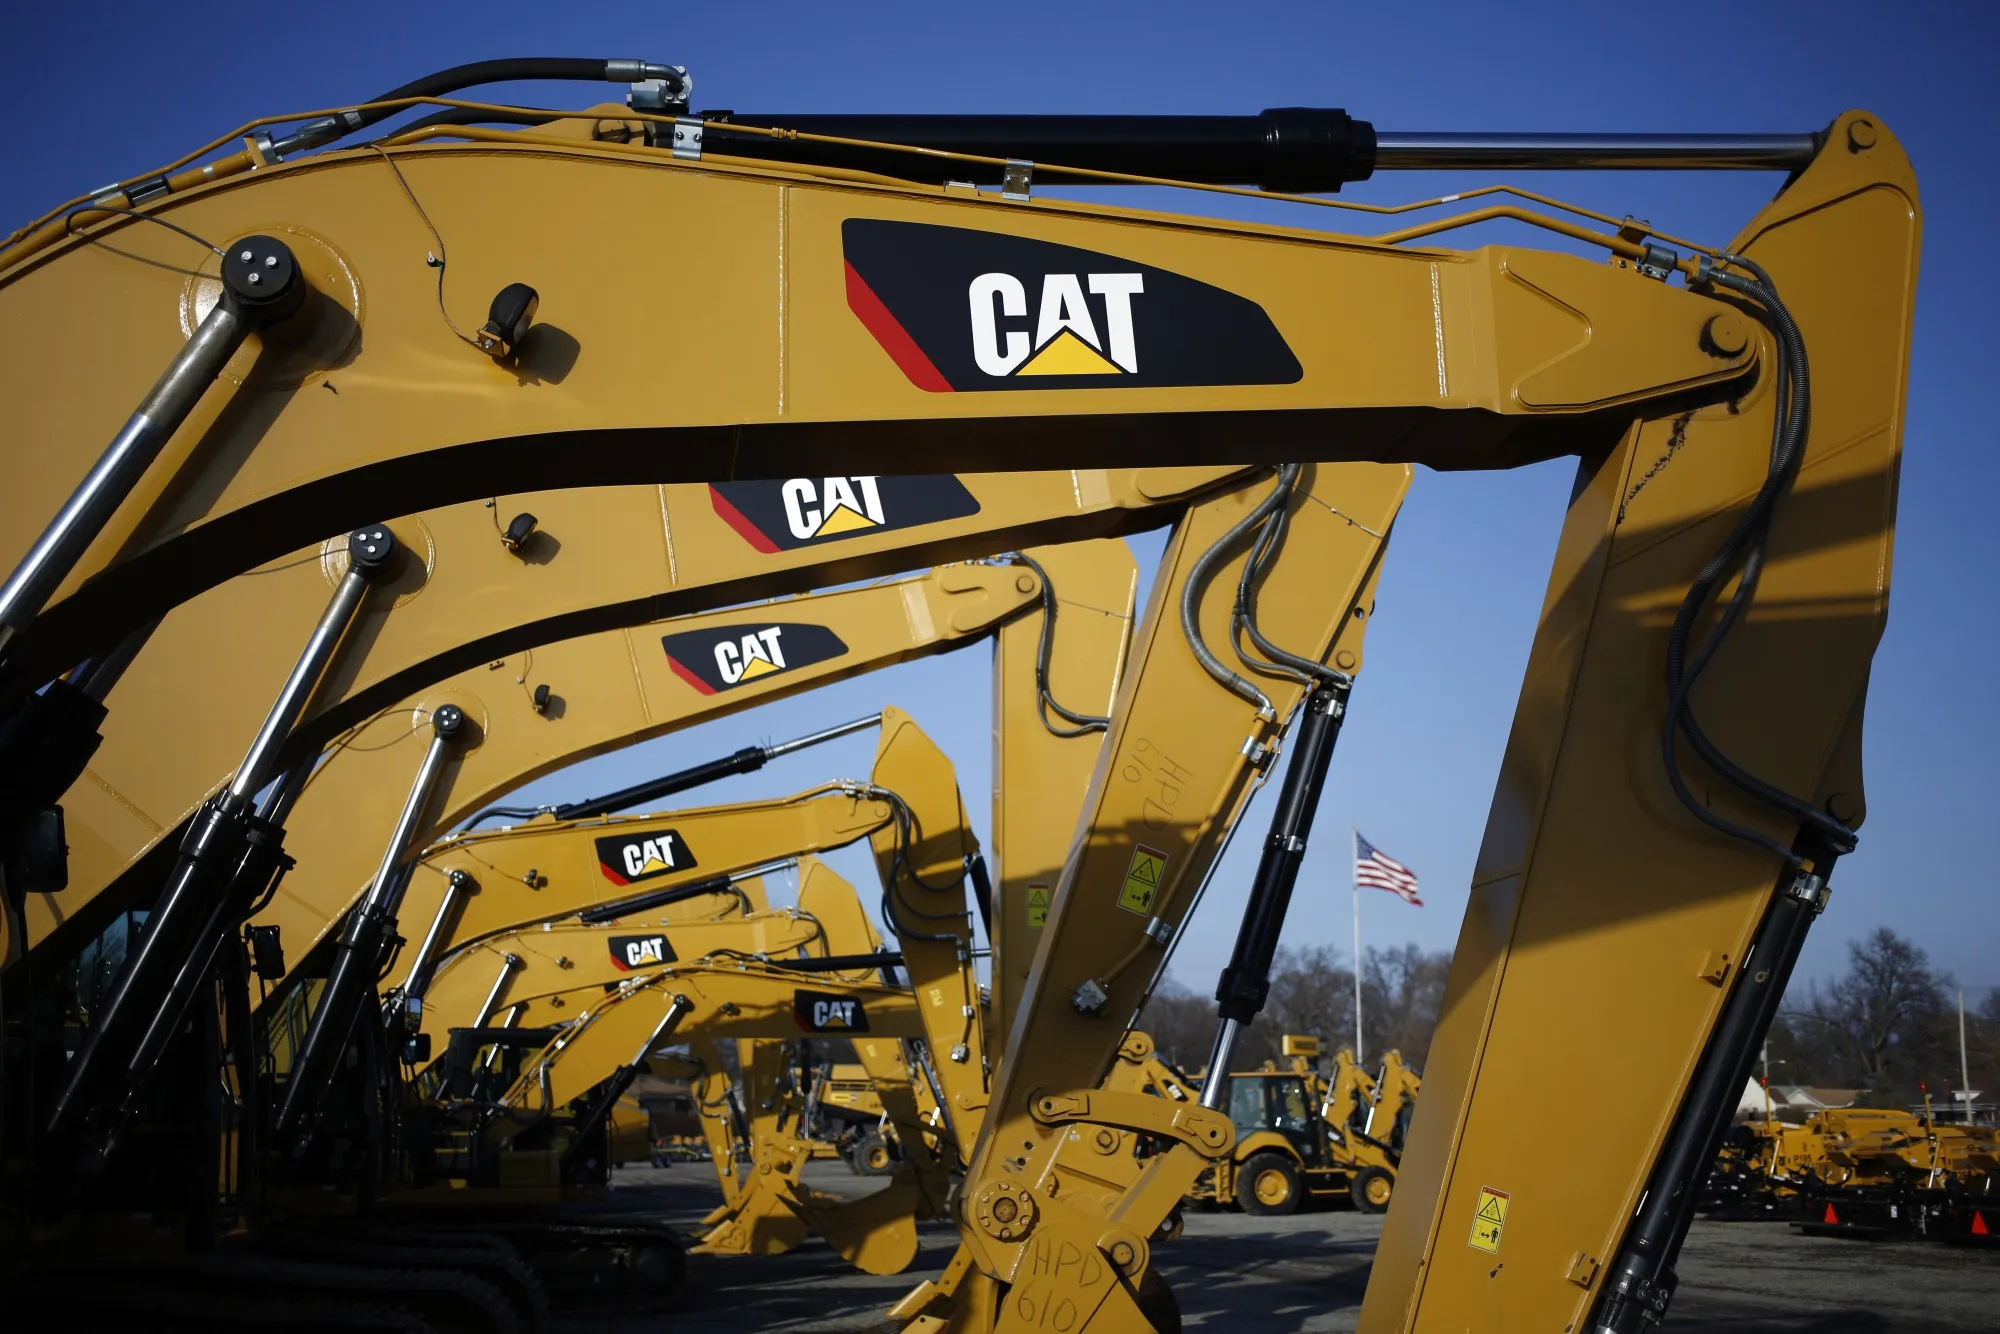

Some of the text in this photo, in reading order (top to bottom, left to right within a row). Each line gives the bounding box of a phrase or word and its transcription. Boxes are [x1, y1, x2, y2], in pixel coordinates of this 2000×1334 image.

[969, 272, 1145, 377] CAT
[781, 476, 886, 540] CAT
[713, 626, 786, 684] CAT
[1143, 756, 1194, 831] HPD
[623, 835, 675, 877] CAT
[626, 937, 663, 966] CAT
[813, 1000, 855, 1027] CAT
[1032, 1238, 1102, 1288] HPD
[1017, 1279, 1078, 1333] 610
